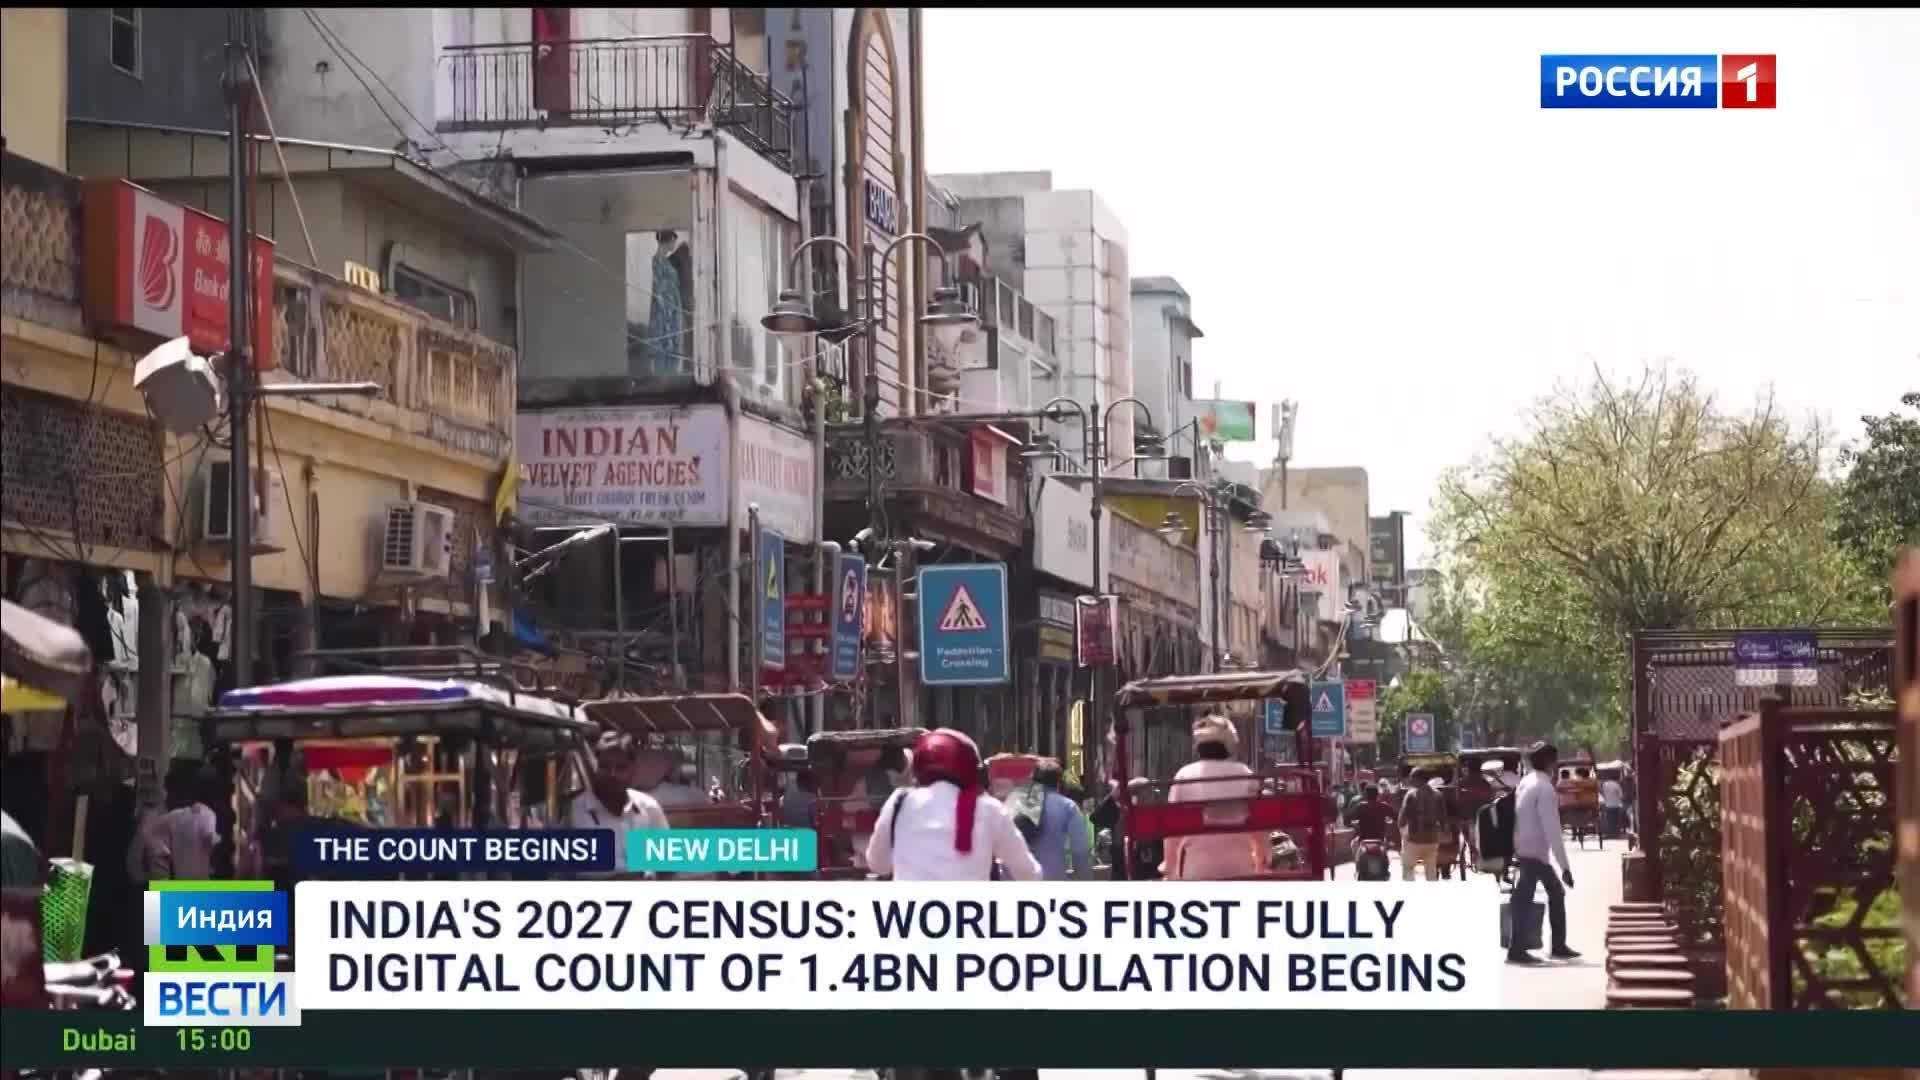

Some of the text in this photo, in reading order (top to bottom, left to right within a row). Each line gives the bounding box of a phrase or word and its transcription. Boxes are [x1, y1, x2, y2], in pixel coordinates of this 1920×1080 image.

[542, 425, 679, 457] INDIAN
[527, 460, 701, 488] VELVET AGENCIES
